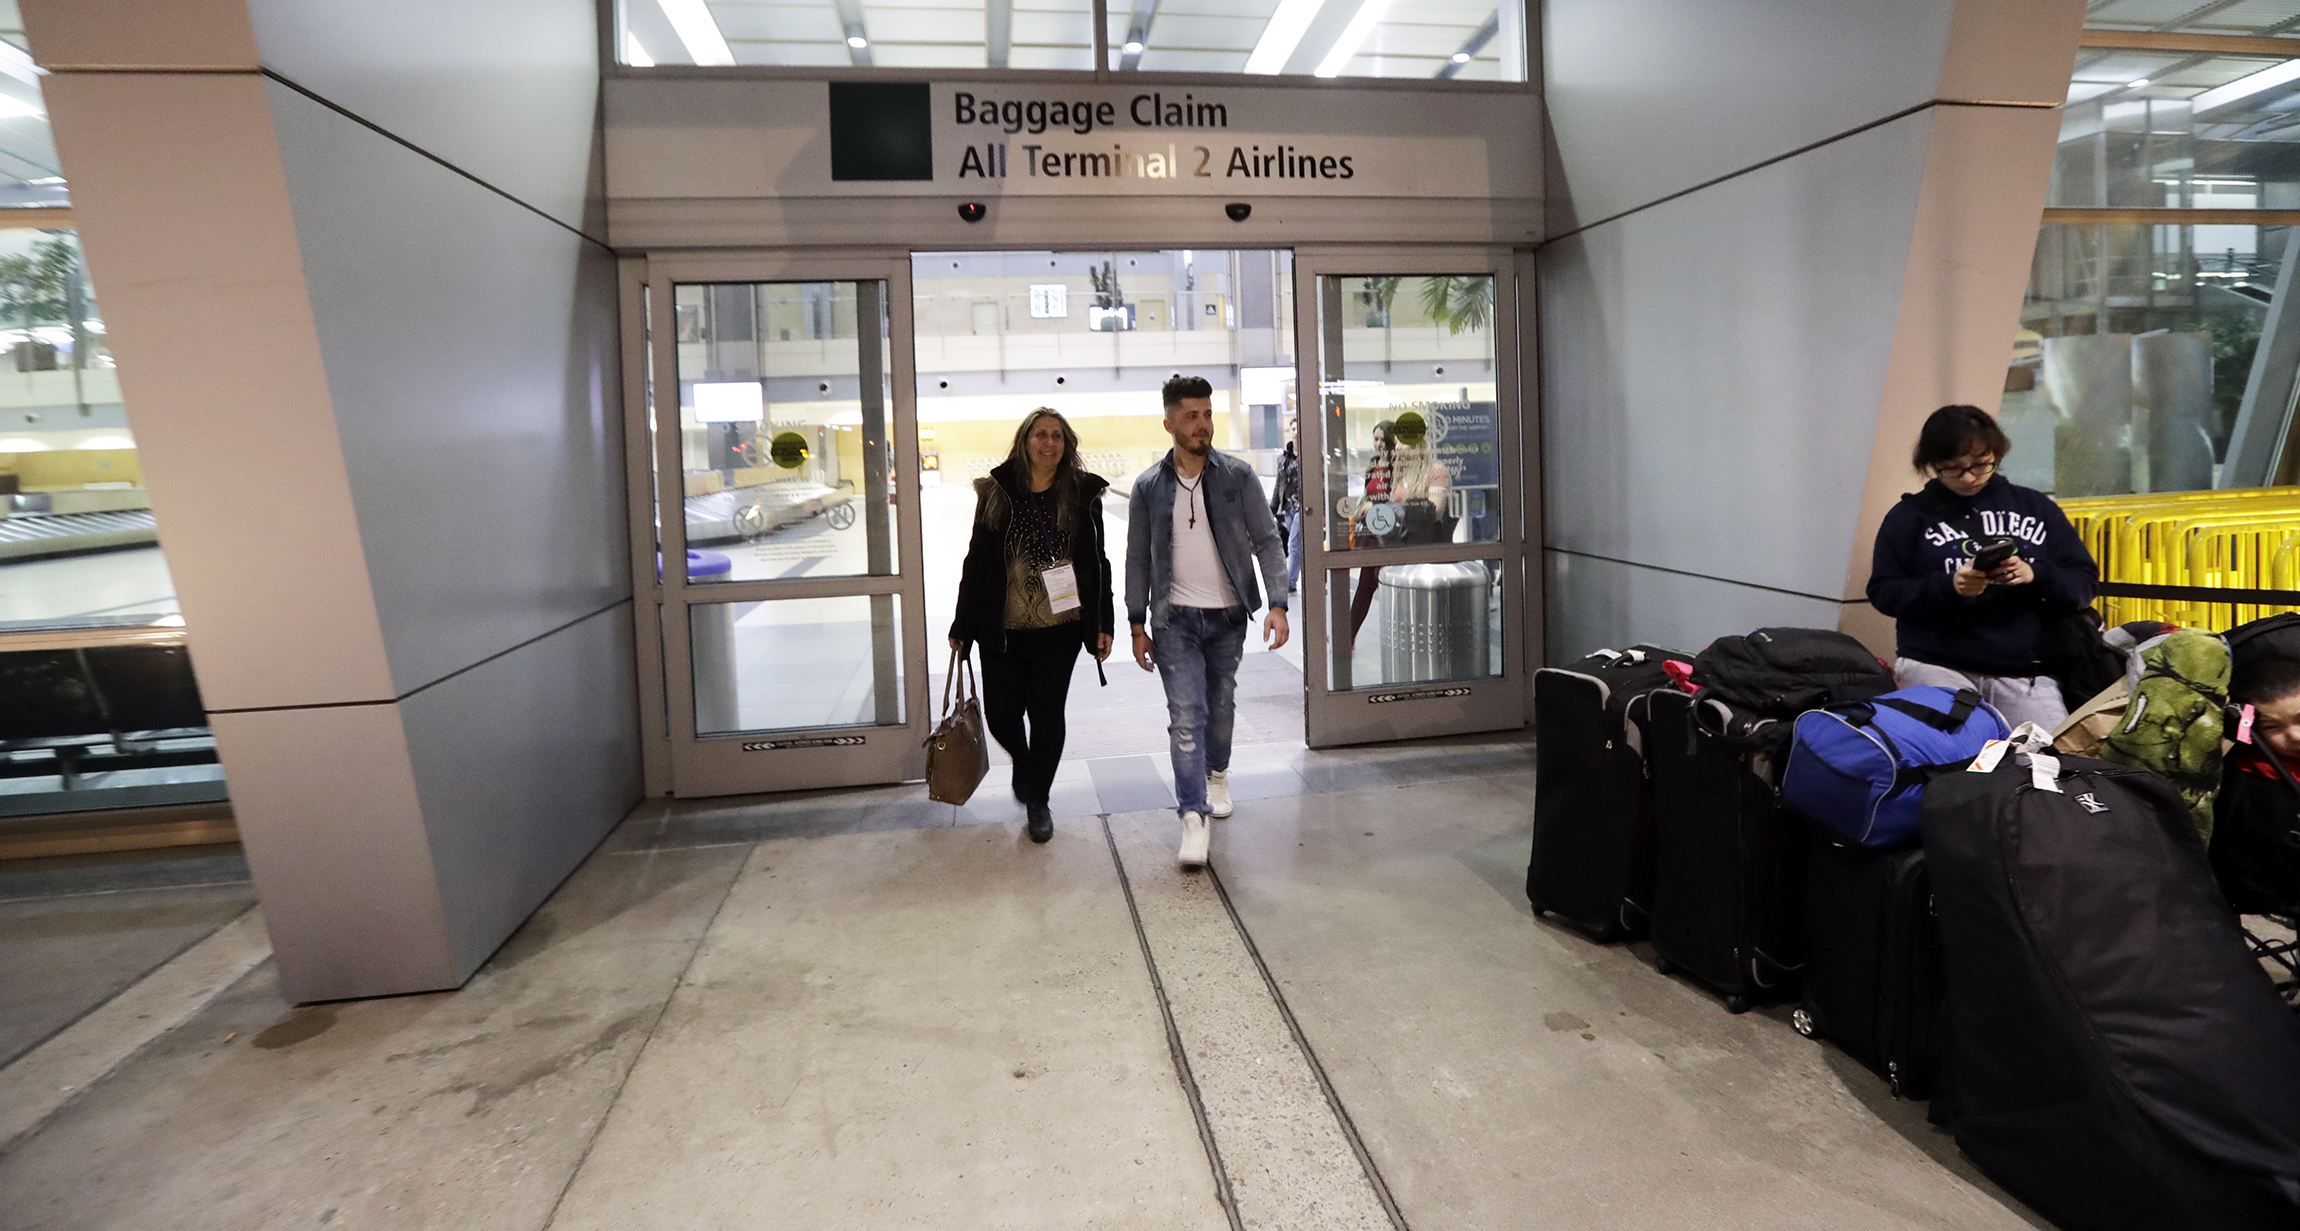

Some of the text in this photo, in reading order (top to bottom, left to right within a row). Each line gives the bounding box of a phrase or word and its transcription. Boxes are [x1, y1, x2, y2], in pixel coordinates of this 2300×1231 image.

[955, 92, 1228, 134] Baggage Claim
[958, 143, 1354, 179] All Terminal 2 Airlines
[1389, 400, 1471, 411] NO SMOKING
[1452, 415, 1491, 424] MINUTES
[1924, 510, 2047, 546] SA DIEGO
